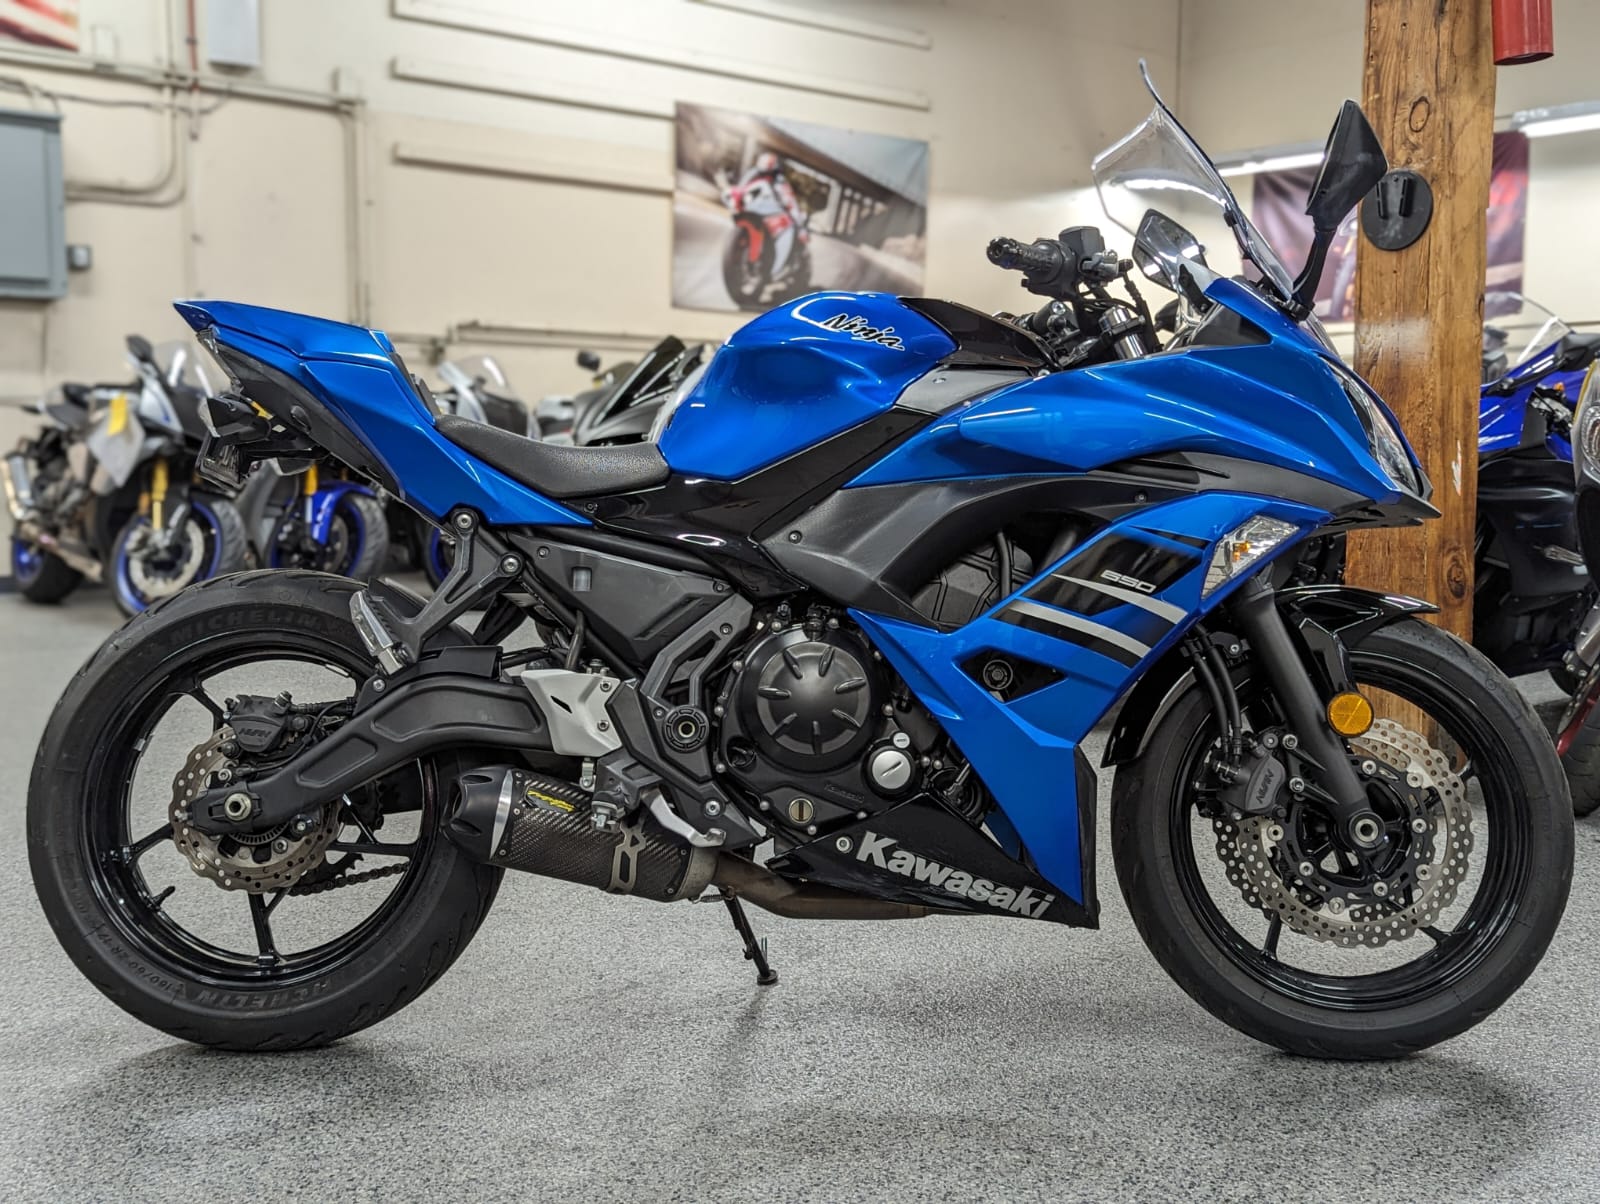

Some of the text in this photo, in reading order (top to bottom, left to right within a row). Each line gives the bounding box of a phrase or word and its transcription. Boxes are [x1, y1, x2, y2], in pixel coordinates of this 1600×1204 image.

[822, 313, 905, 351] Ninja
[1101, 569, 1157, 593] 650
[170, 610, 319, 643] MICHELIN
[856, 831, 1055, 918] Kawasaki
